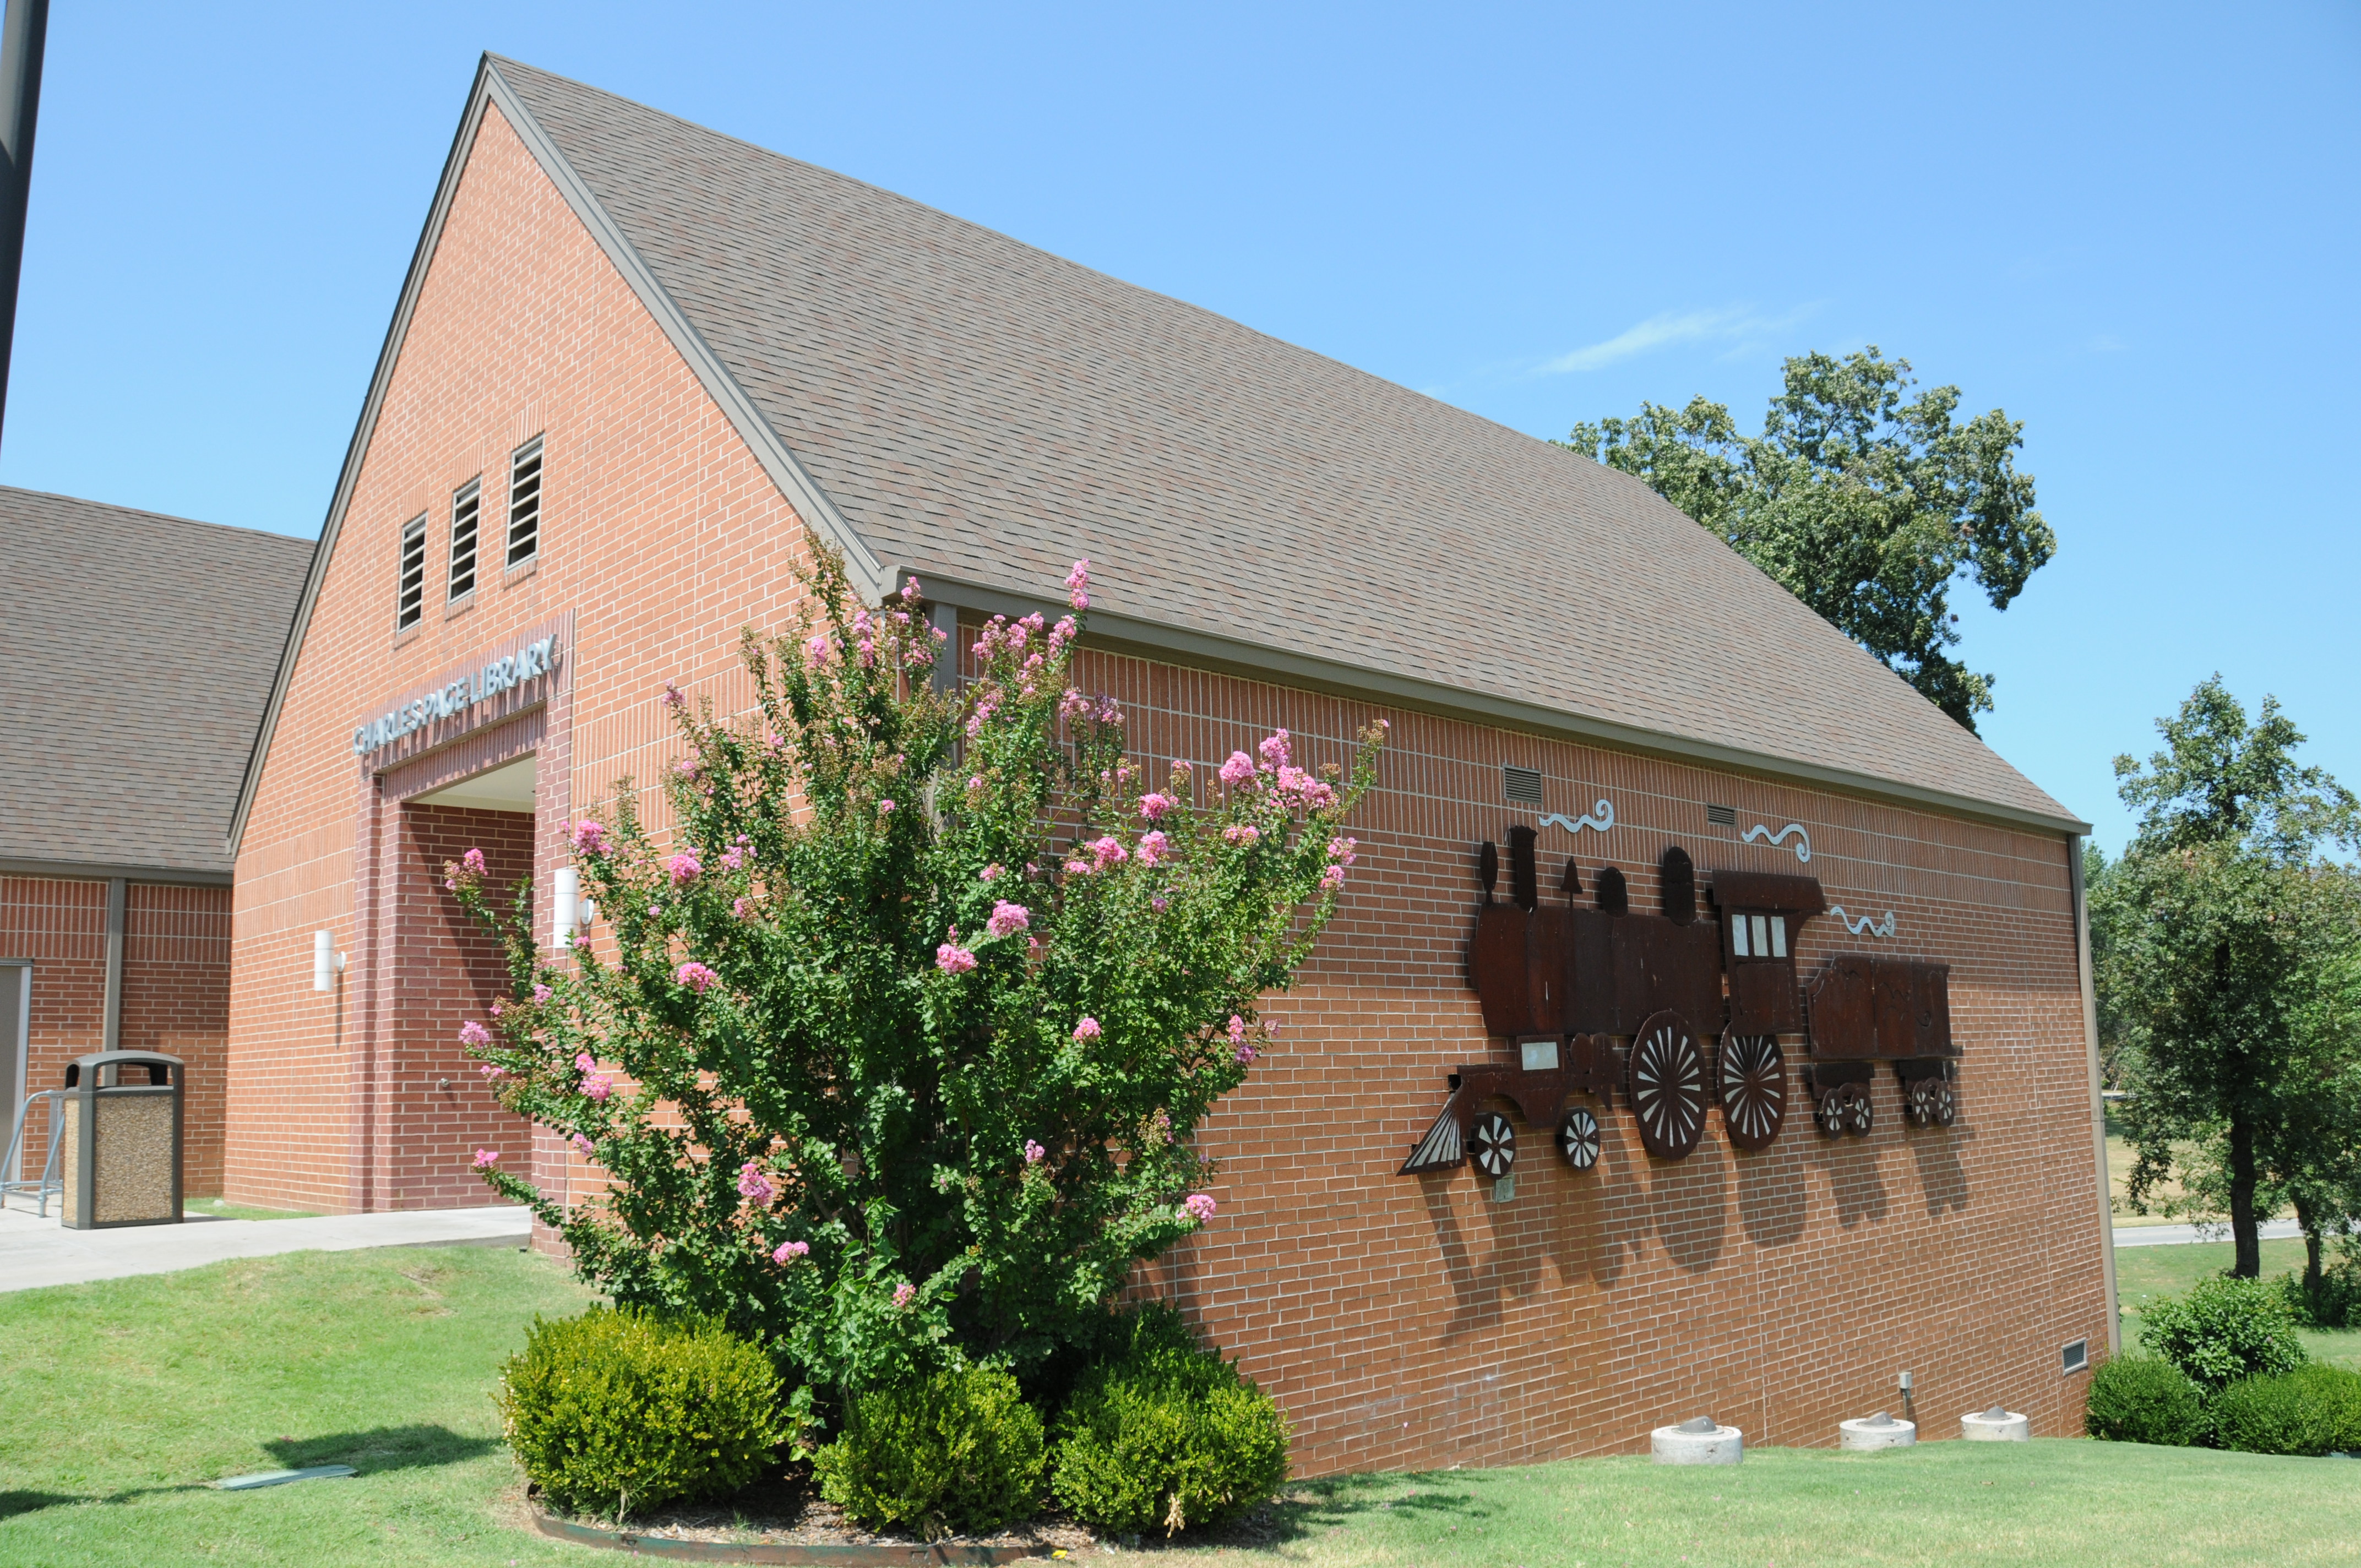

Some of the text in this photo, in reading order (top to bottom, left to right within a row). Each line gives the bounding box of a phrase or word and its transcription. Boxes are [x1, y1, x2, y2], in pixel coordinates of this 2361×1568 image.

[353, 634, 557, 755] CHARLES PAGE LIBRARY
